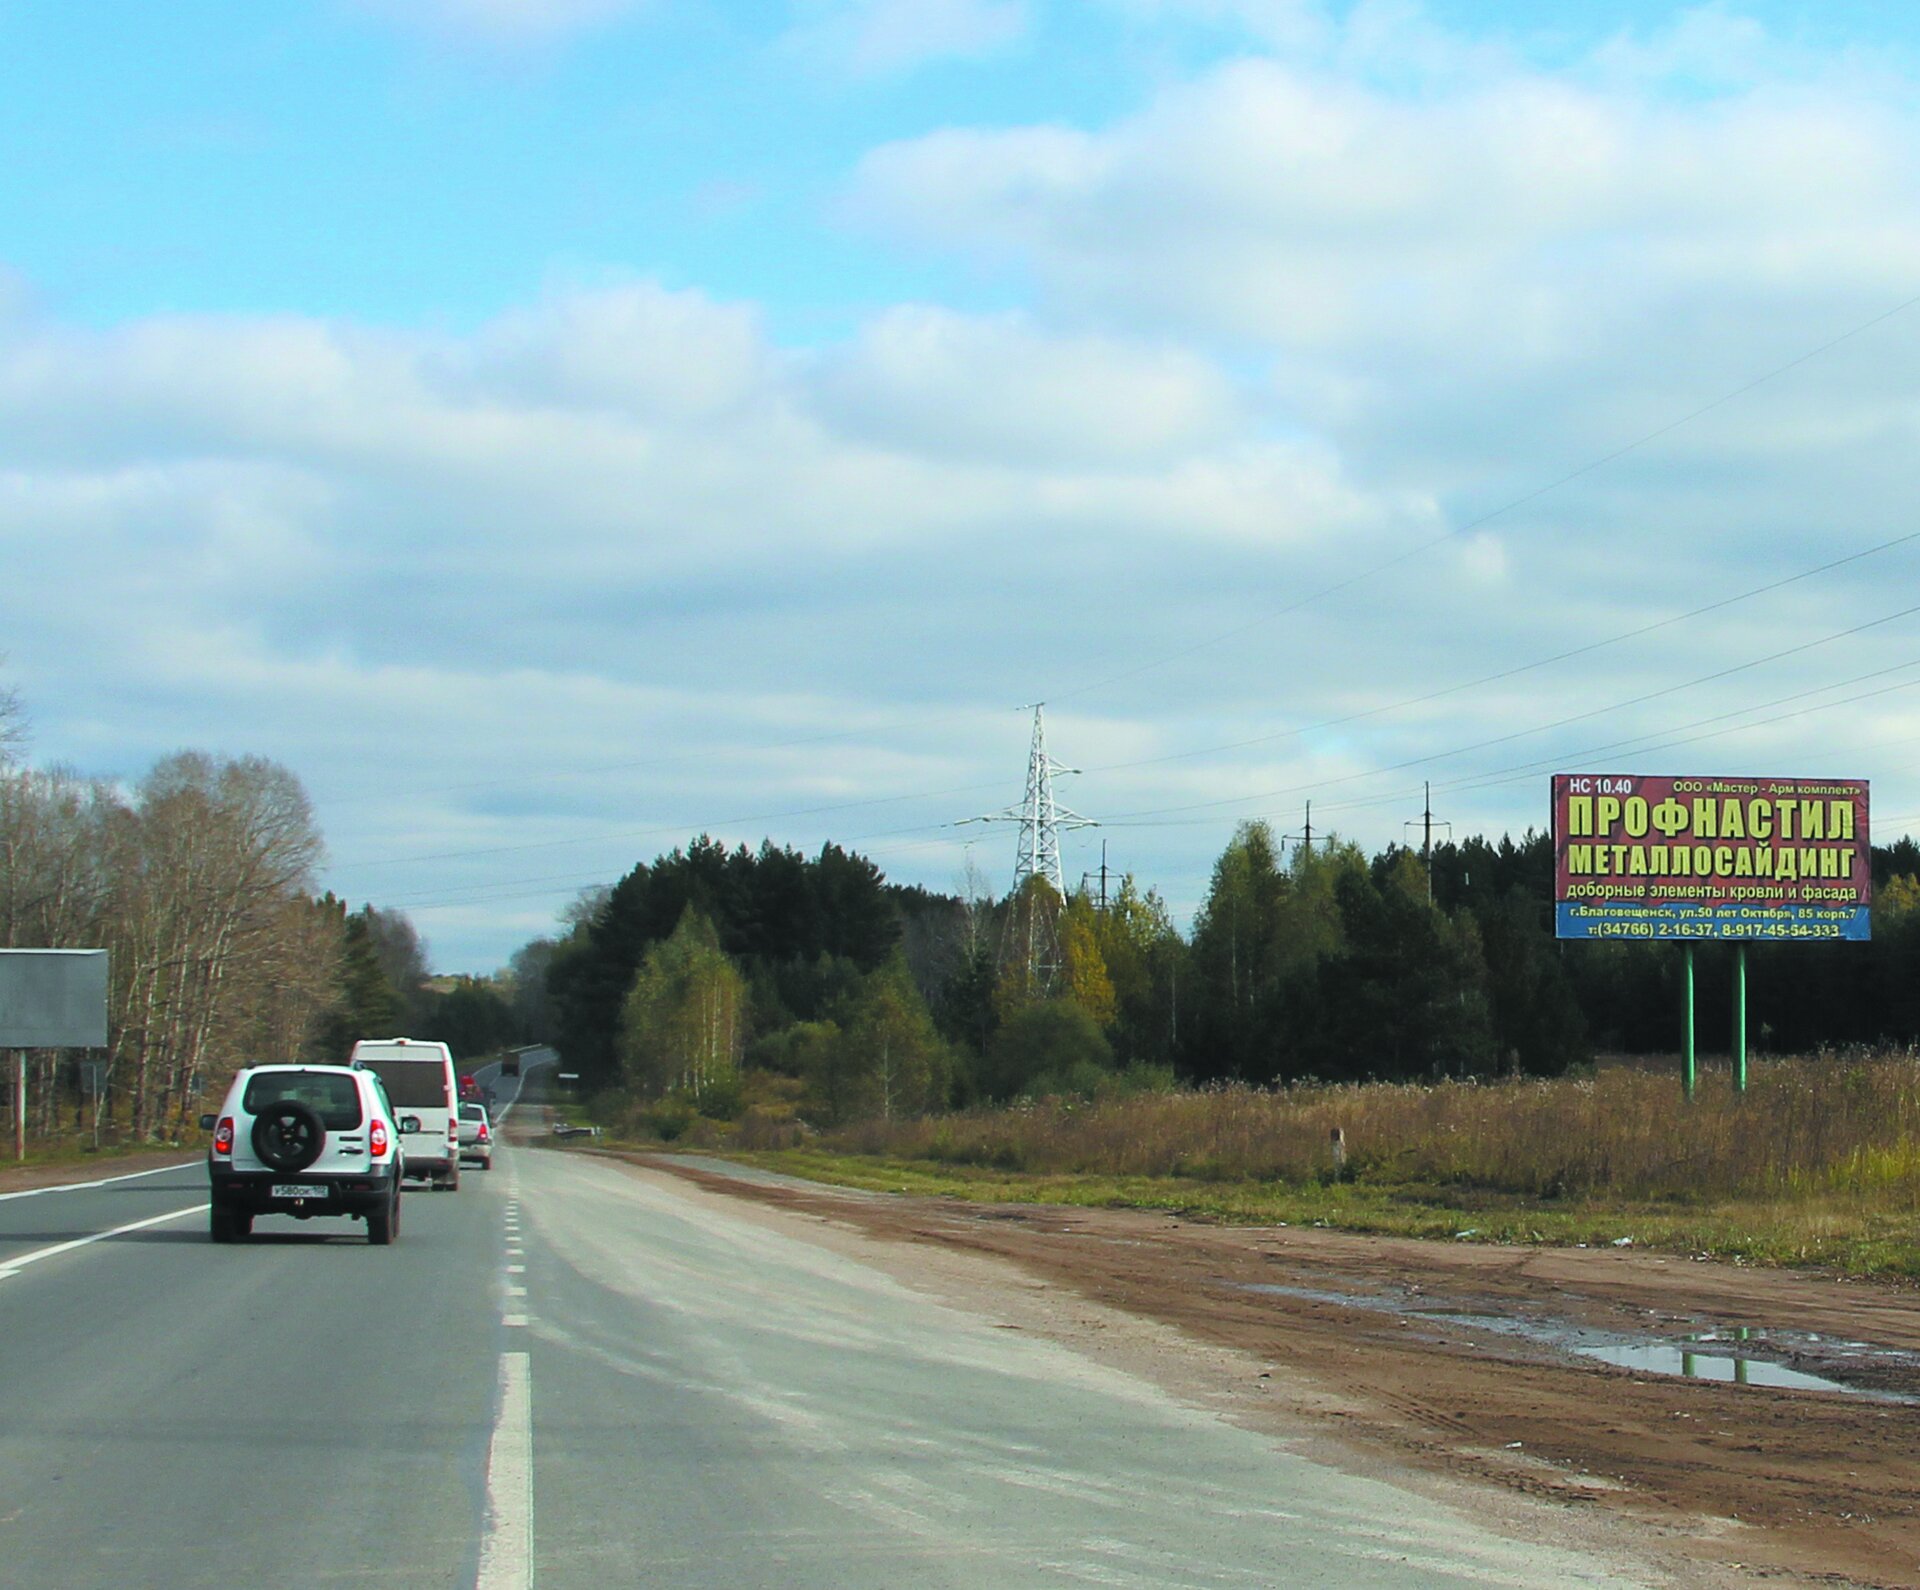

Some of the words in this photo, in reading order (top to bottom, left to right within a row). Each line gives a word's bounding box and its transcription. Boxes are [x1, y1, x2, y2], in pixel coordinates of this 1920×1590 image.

[1570, 778, 1591, 793] НС
[1595, 778, 1632, 794] 10.40
[1673, 781, 1703, 792] ООО
[1706, 782, 1758, 796] «Мастер
[1768, 783, 1794, 796] Арм
[1797, 786, 1861, 796] комплект»
[1569, 796, 1854, 840] ПРОФНАСТИЛ
[1568, 841, 1855, 881] МЕТАЛЛОСАЙДИНГ
[1566, 881, 1646, 899] доборные
[1650, 885, 1726, 898] элементы
[1730, 886, 1784, 901] кровли
[1788, 888, 1797, 898] и
[1801, 884, 1857, 901] фасада
[1570, 906, 1676, 919] г.Благовещенск,
[1679, 907, 1713, 919] ул.50
[1716, 909, 1737, 918] лет
[1740, 908, 1795, 920] Октября,
[1798, 908, 1813, 919] 85
[1816, 908, 1857, 921] корп.7
[1588, 923, 1654, 938] т:(34766)
[1659, 923, 1718, 938] 2-16-37,
[1722, 924, 1840, 938] 8-917-45-54-333
